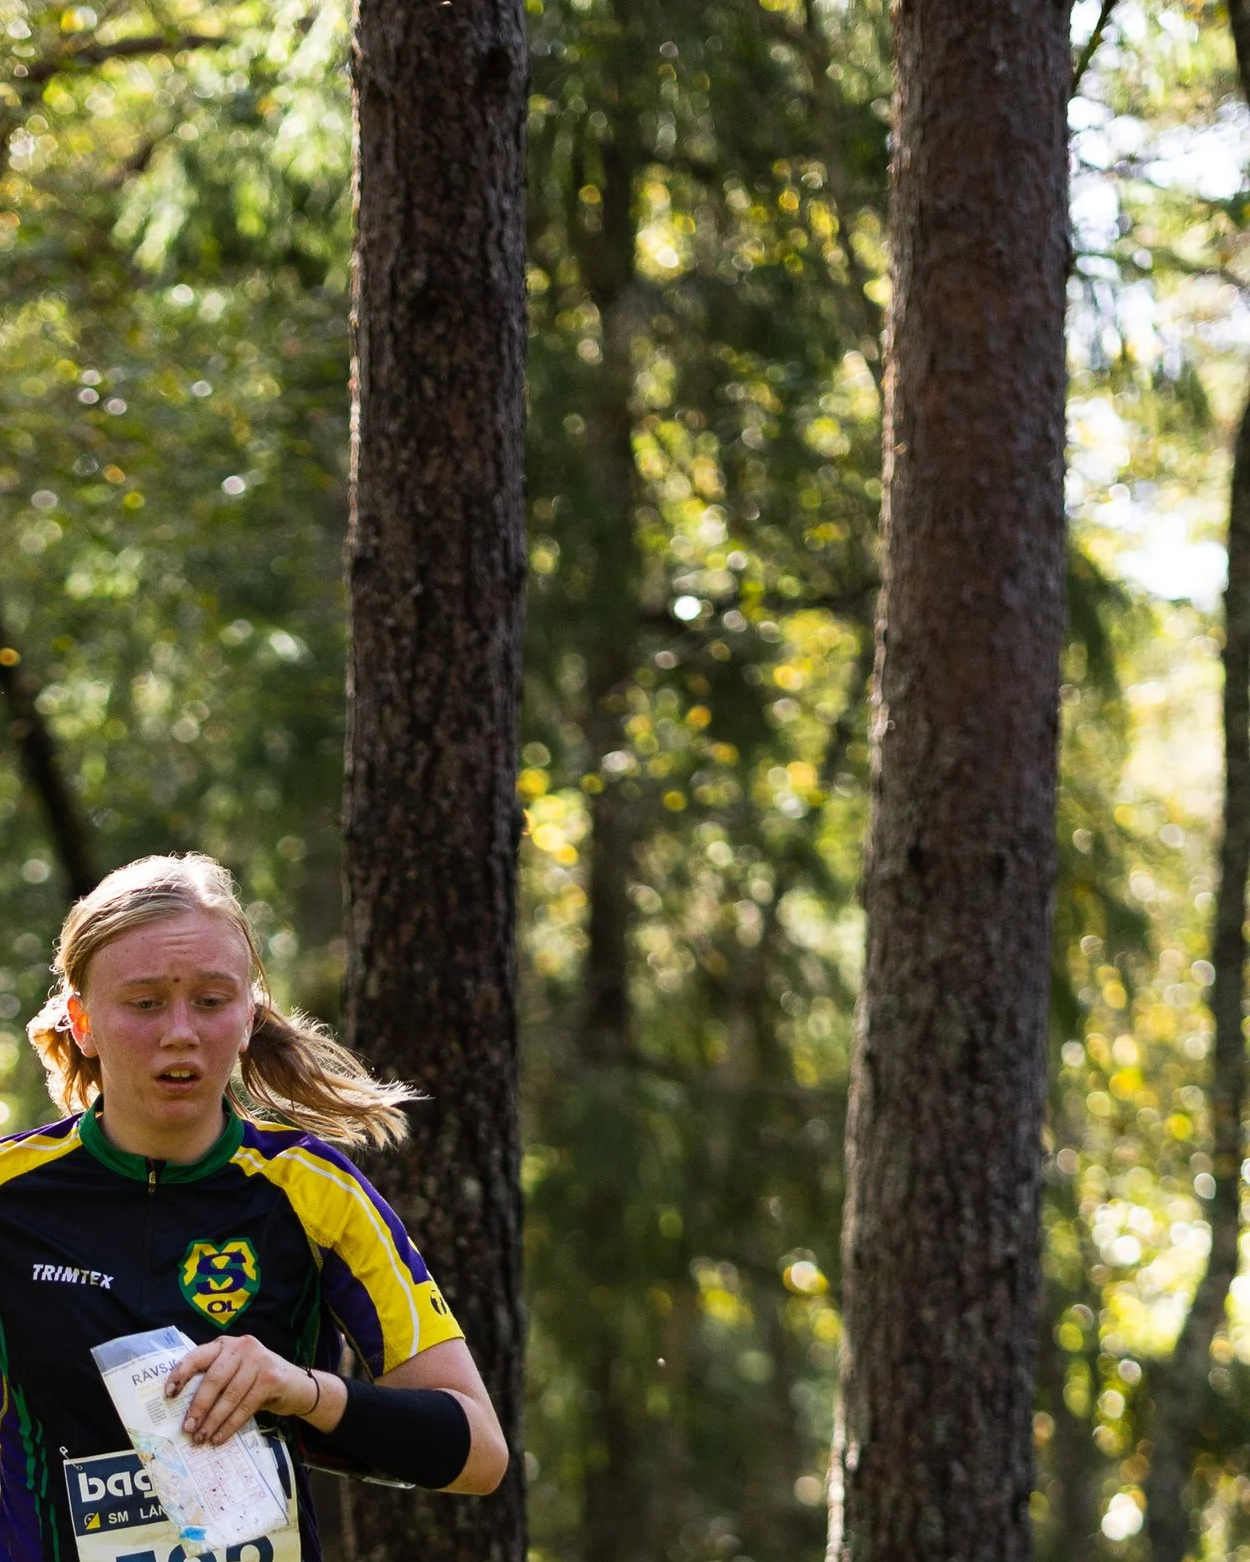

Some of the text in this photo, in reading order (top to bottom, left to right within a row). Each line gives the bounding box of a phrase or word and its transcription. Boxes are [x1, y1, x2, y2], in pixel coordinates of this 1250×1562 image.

[32, 1263, 115, 1290] TRIMTEX
[206, 1300, 239, 1314] OL
[107, 1510, 129, 1524] SM
